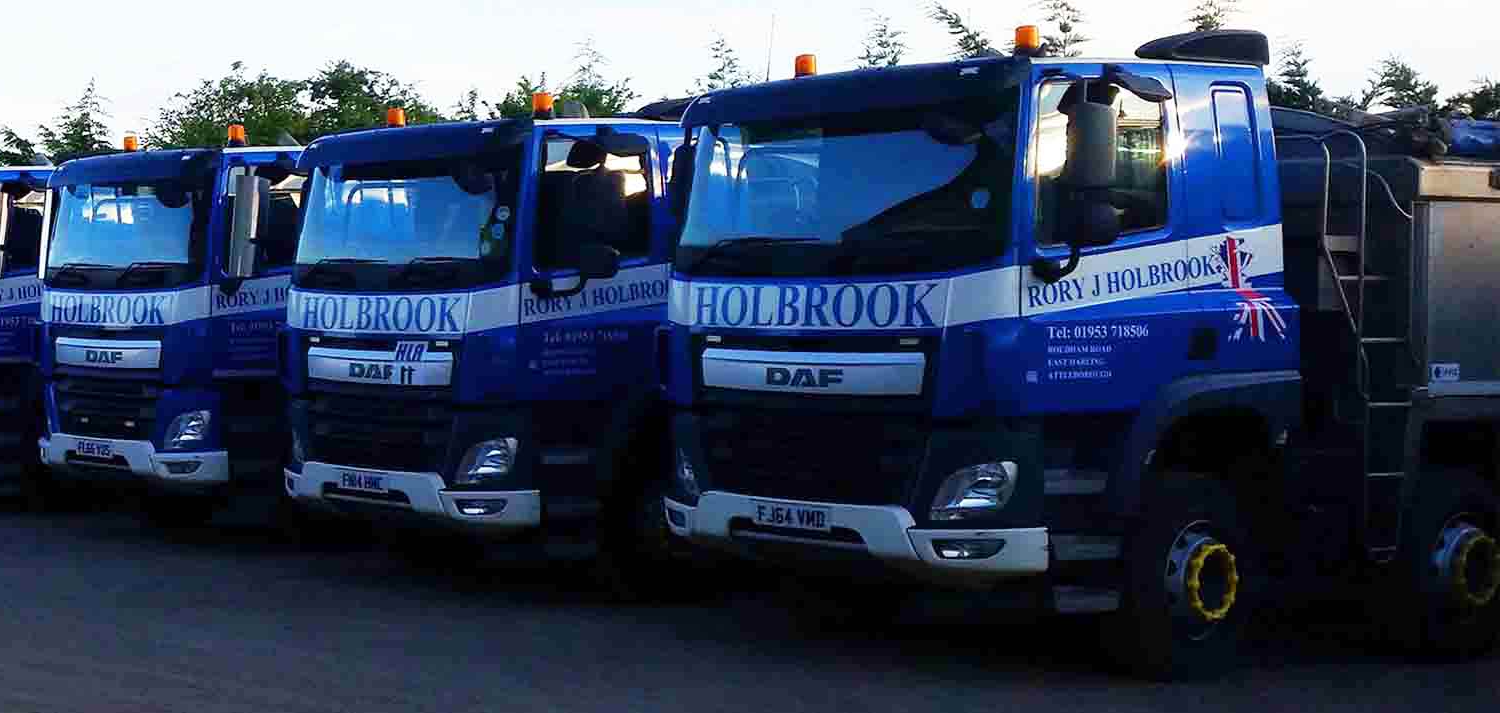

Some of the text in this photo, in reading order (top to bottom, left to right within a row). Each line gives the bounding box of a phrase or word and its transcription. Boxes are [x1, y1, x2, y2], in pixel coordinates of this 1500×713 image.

[1028, 255, 1216, 307] RORY J HOLBROOK
[52, 295, 164, 324] HOLBROOK
[217, 288, 258, 309] RORY
[524, 295, 572, 316] RORY
[580, 288, 588, 307] J
[694, 283, 939, 328] HOLBROOK
[303, 296, 460, 332] HOLBROOK
[1048, 324, 1149, 339] Tel: 01953 718506
[85, 350, 124, 363] DAF
[766, 367, 844, 388] DAF
